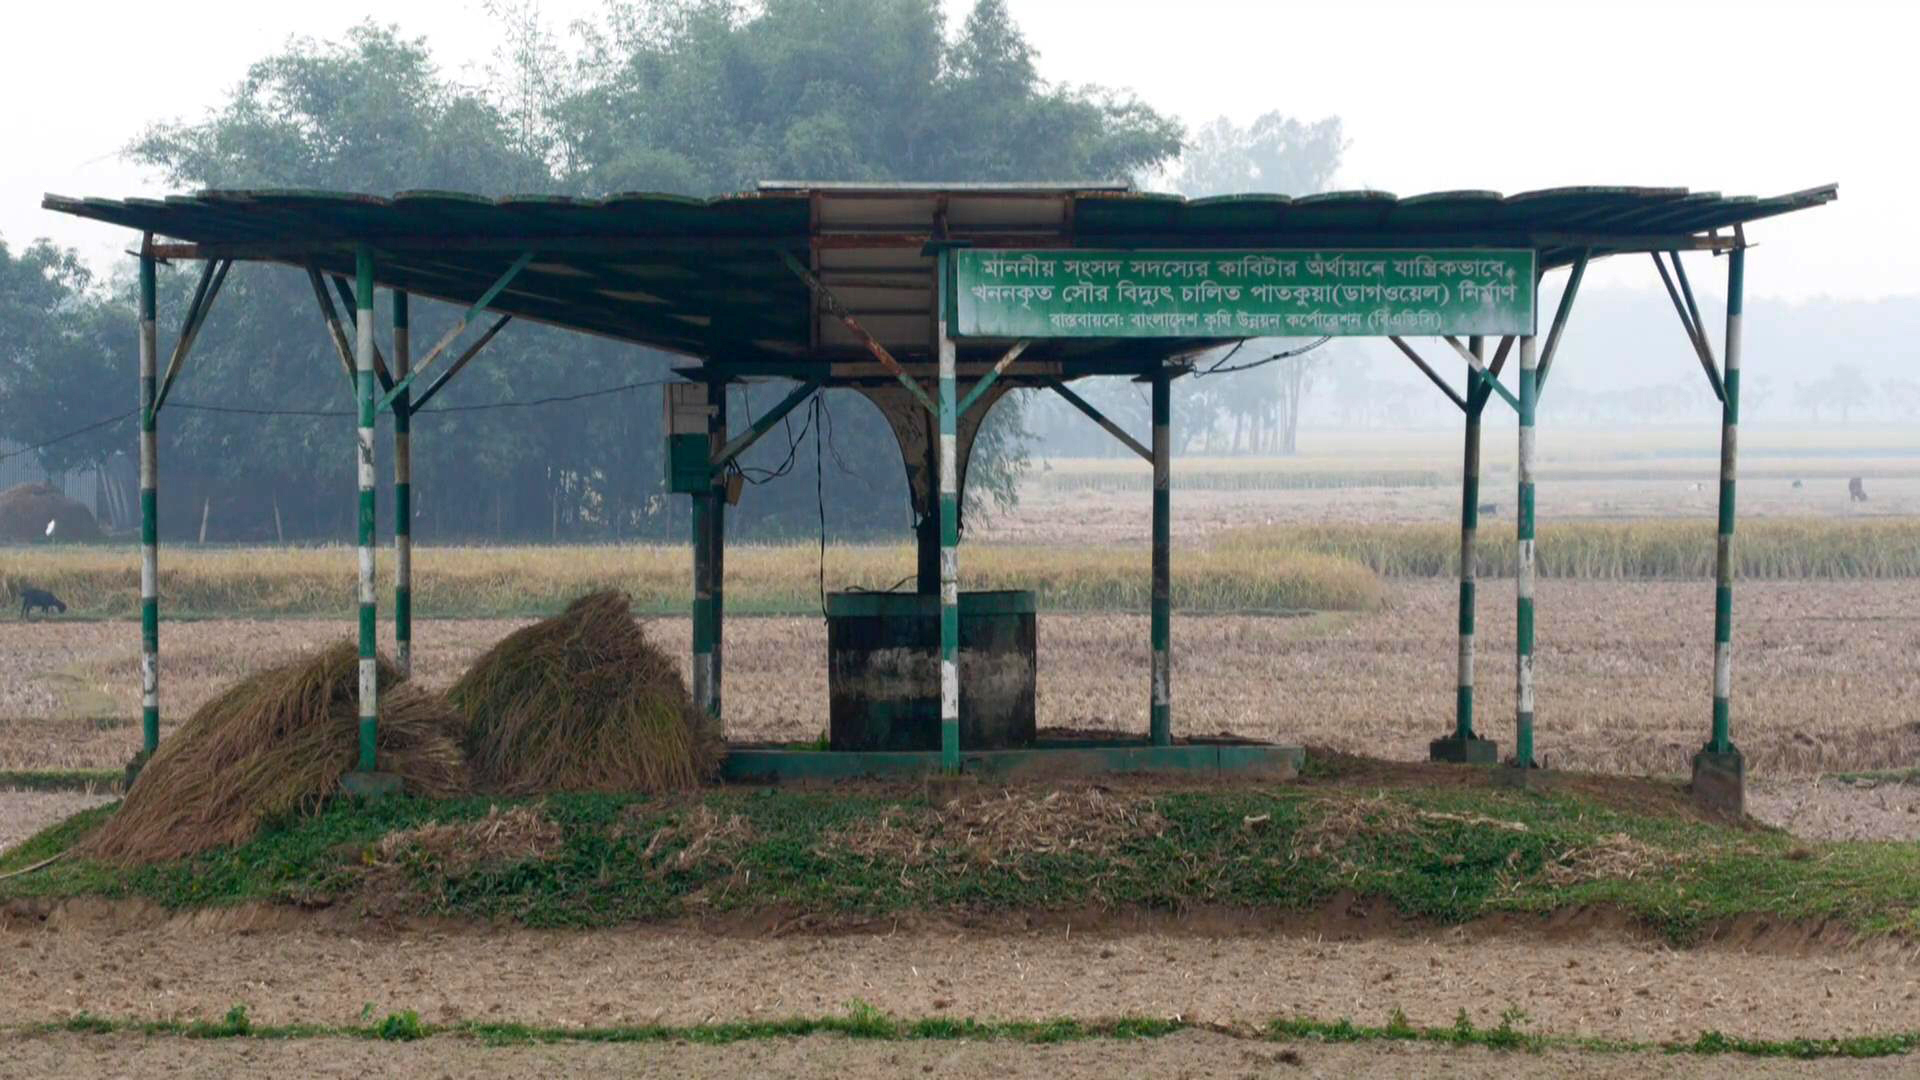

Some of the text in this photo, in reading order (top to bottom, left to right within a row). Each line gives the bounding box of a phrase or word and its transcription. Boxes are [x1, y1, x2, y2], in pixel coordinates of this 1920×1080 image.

[982, 254, 1057, 278] মাননীয়
[1063, 259, 1124, 279] সংসদ
[1130, 259, 1211, 278] সদস্যের
[970, 282, 1056, 310] খননকৃত
[1062, 280, 1110, 304] সৌর
[1116, 279, 1175, 308] বিদ্যুৎ
[1179, 280, 1244, 303] চালিত
[1457, 279, 1518, 304] নির্মাণ
[1128, 312, 1199, 332] বাংলাদেশ
[1202, 309, 1232, 334] কৃষি
[1235, 309, 1281, 329] উন্নয়ন
